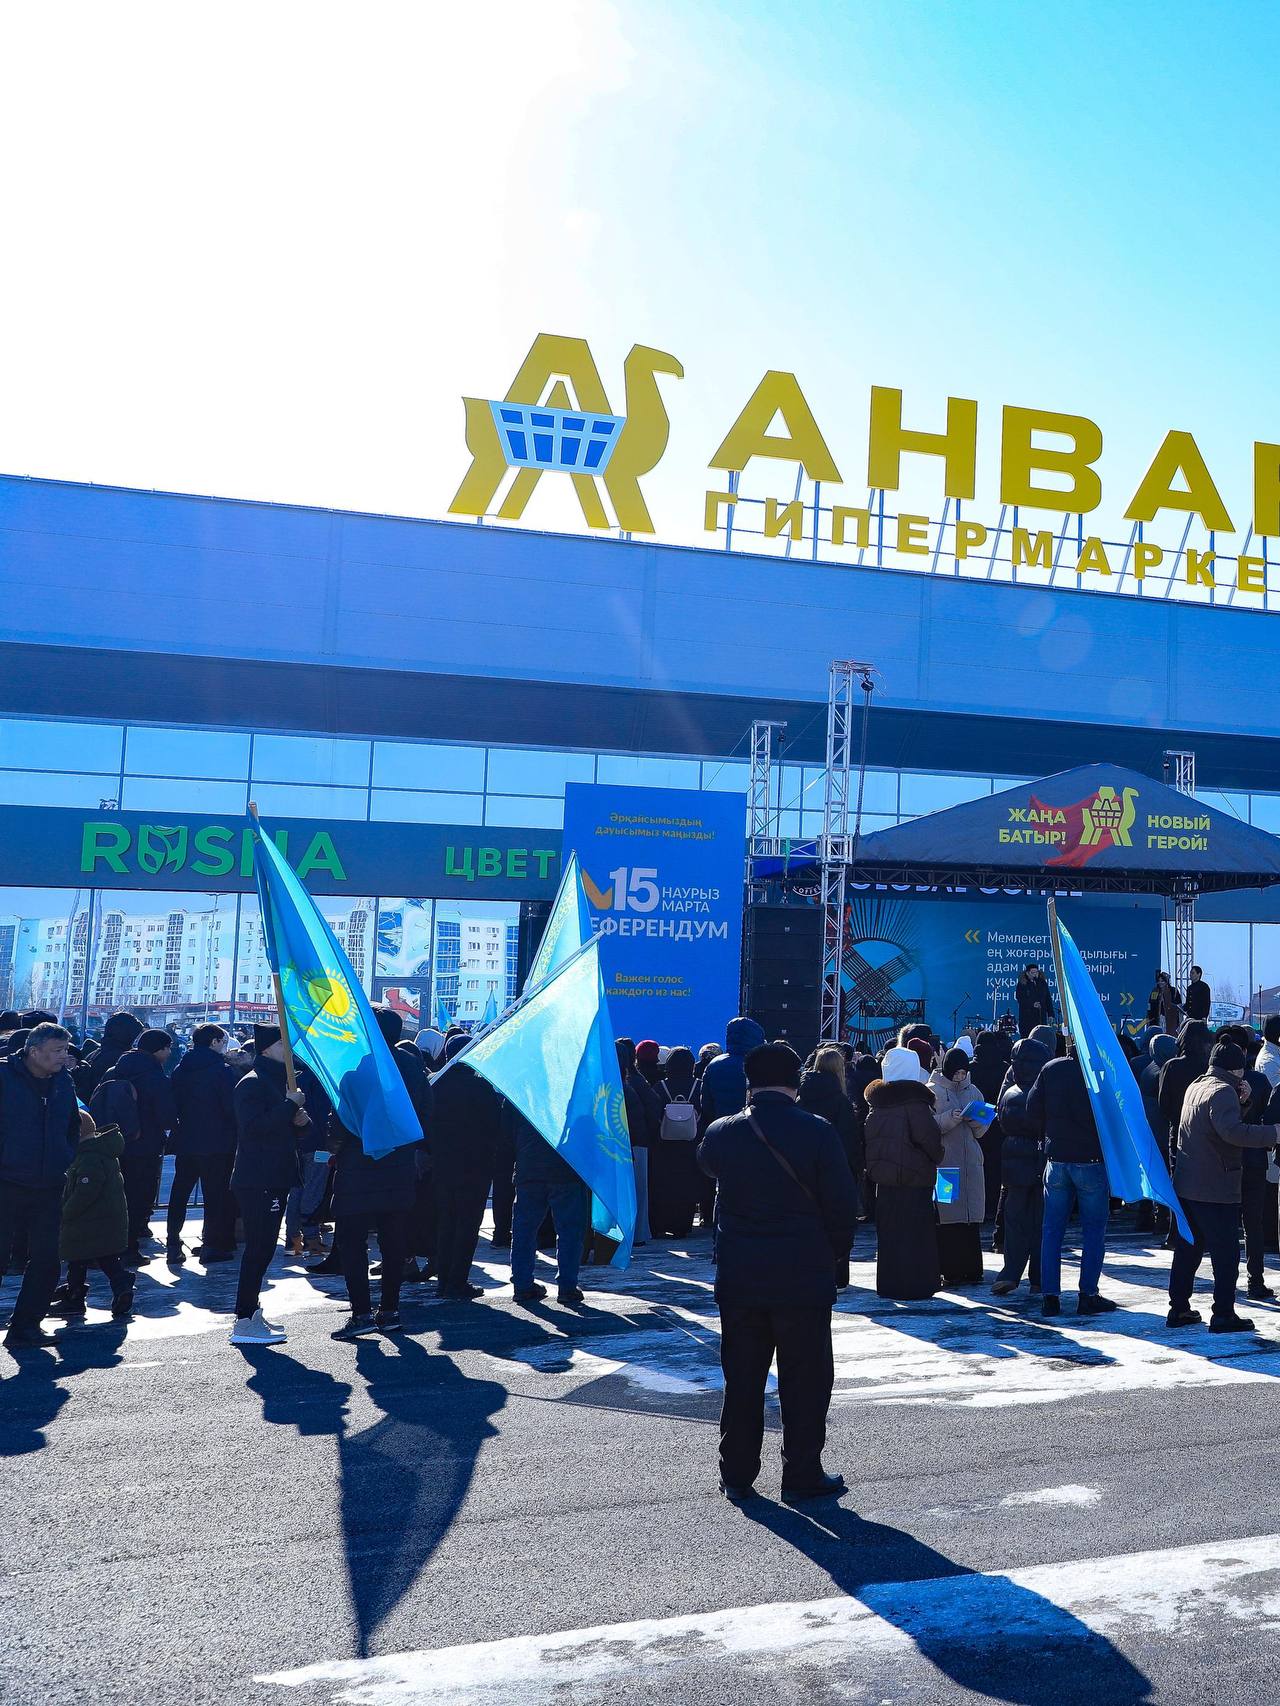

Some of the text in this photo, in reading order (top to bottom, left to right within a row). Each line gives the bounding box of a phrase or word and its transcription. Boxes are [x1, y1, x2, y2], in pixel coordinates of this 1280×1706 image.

[1008, 808, 1067, 826] ЖАҢА
[1147, 814, 1211, 831] НОВЫЙ
[999, 828, 1067, 845] БАТЫР!
[1147, 834, 1208, 850] ГЕРОЙ!
[445, 847, 561, 881] ЦВЕТ
[609, 867, 720, 912] 15 НАУРЫЗ
[662, 900, 710, 912] МАРТА
[590, 916, 728, 941] ЕФЕРЕНДУМ
[986, 963, 1018, 974] адам
[615, 972, 683, 984] Важен голос
[655, 988, 668, 997] из
[670, 986, 691, 997] нас!
